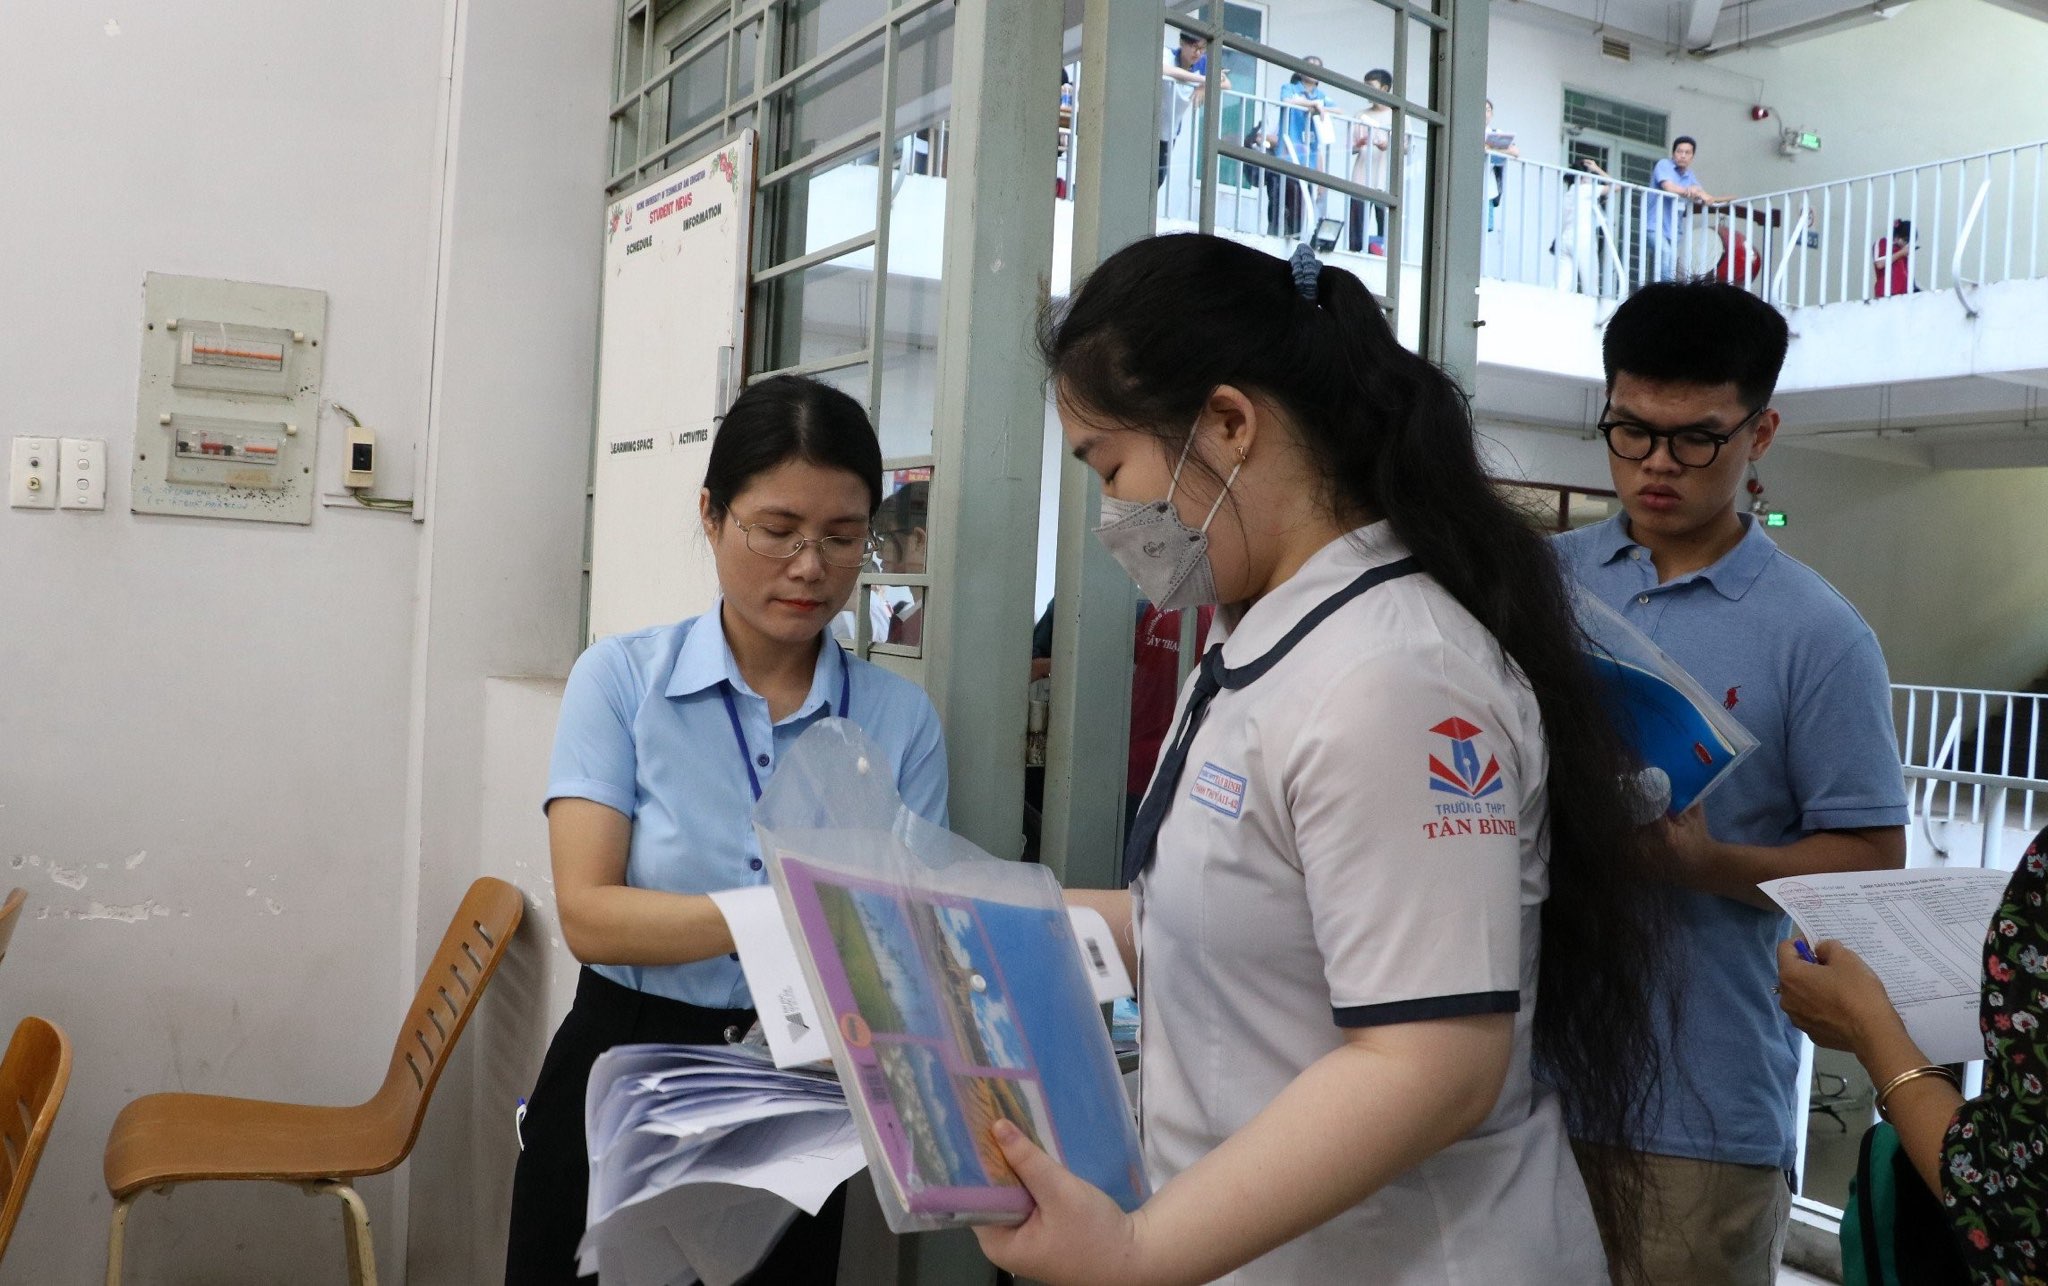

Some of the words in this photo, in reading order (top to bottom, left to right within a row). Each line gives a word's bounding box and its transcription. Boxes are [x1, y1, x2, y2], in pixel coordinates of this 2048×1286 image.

[649, 199, 674, 225] STUDENT
[675, 191, 693, 212] NEWS
[683, 203, 722, 232] INFORMATION
[626, 235, 653, 256] SCHEDULE
[610, 440, 636, 454] LEARNING
[636, 437, 654, 451] SPACE
[678, 429, 708, 445] ACTIVITIES
[1485, 802, 1506, 815] THPT
[1423, 816, 1472, 840] TÂN
[1479, 814, 1517, 837] BÌNH
